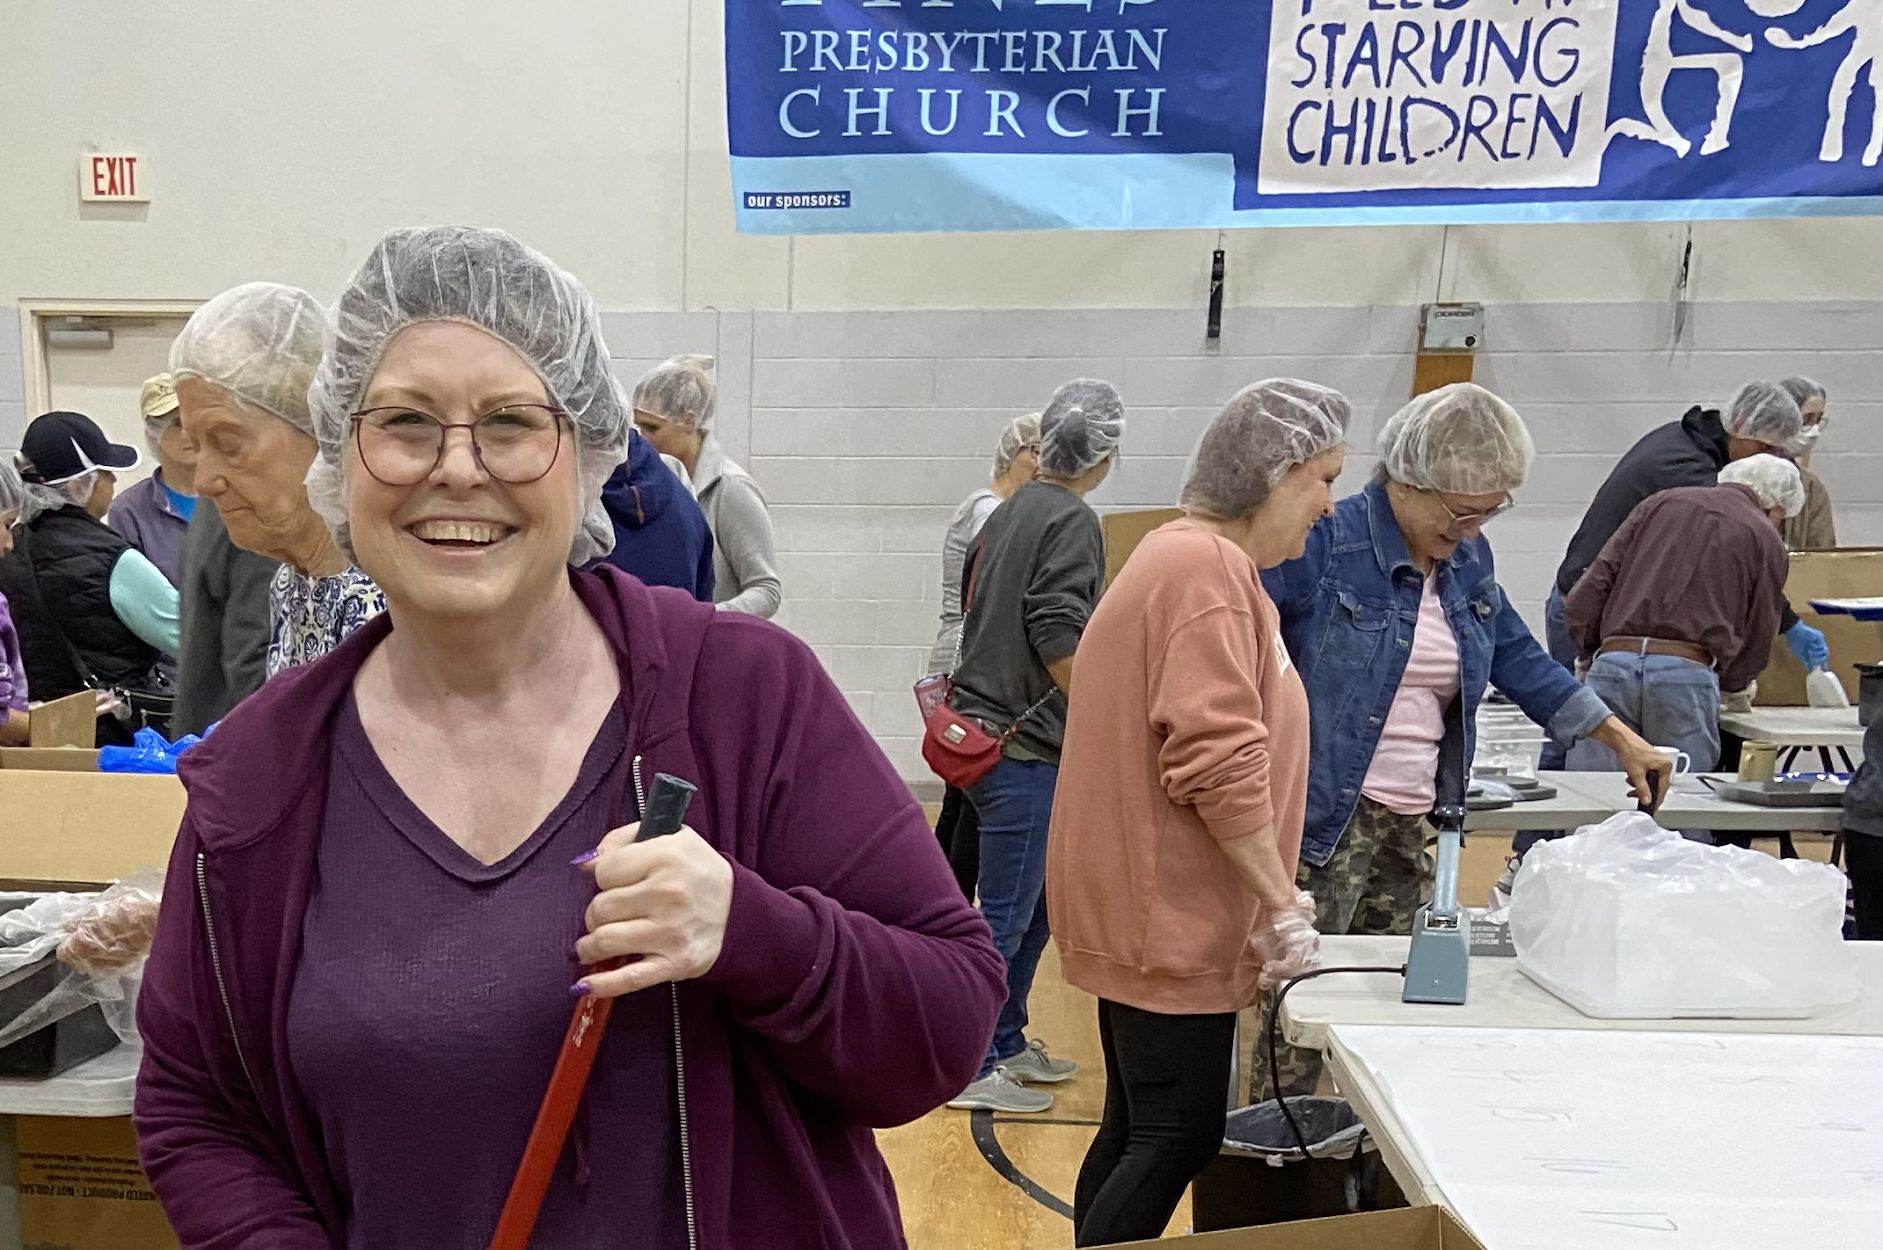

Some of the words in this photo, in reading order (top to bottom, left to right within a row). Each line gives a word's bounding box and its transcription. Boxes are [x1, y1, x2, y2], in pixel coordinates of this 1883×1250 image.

[779, 28, 1168, 75] PRESBYTERIAN
[1291, 17, 1580, 89] STARVING
[778, 85, 1167, 139] CHURCH
[1287, 92, 1583, 166] CHILDREN
[92, 157, 137, 196] EXIT
[747, 195, 772, 208] our
[775, 194, 847, 210] sponsors:
